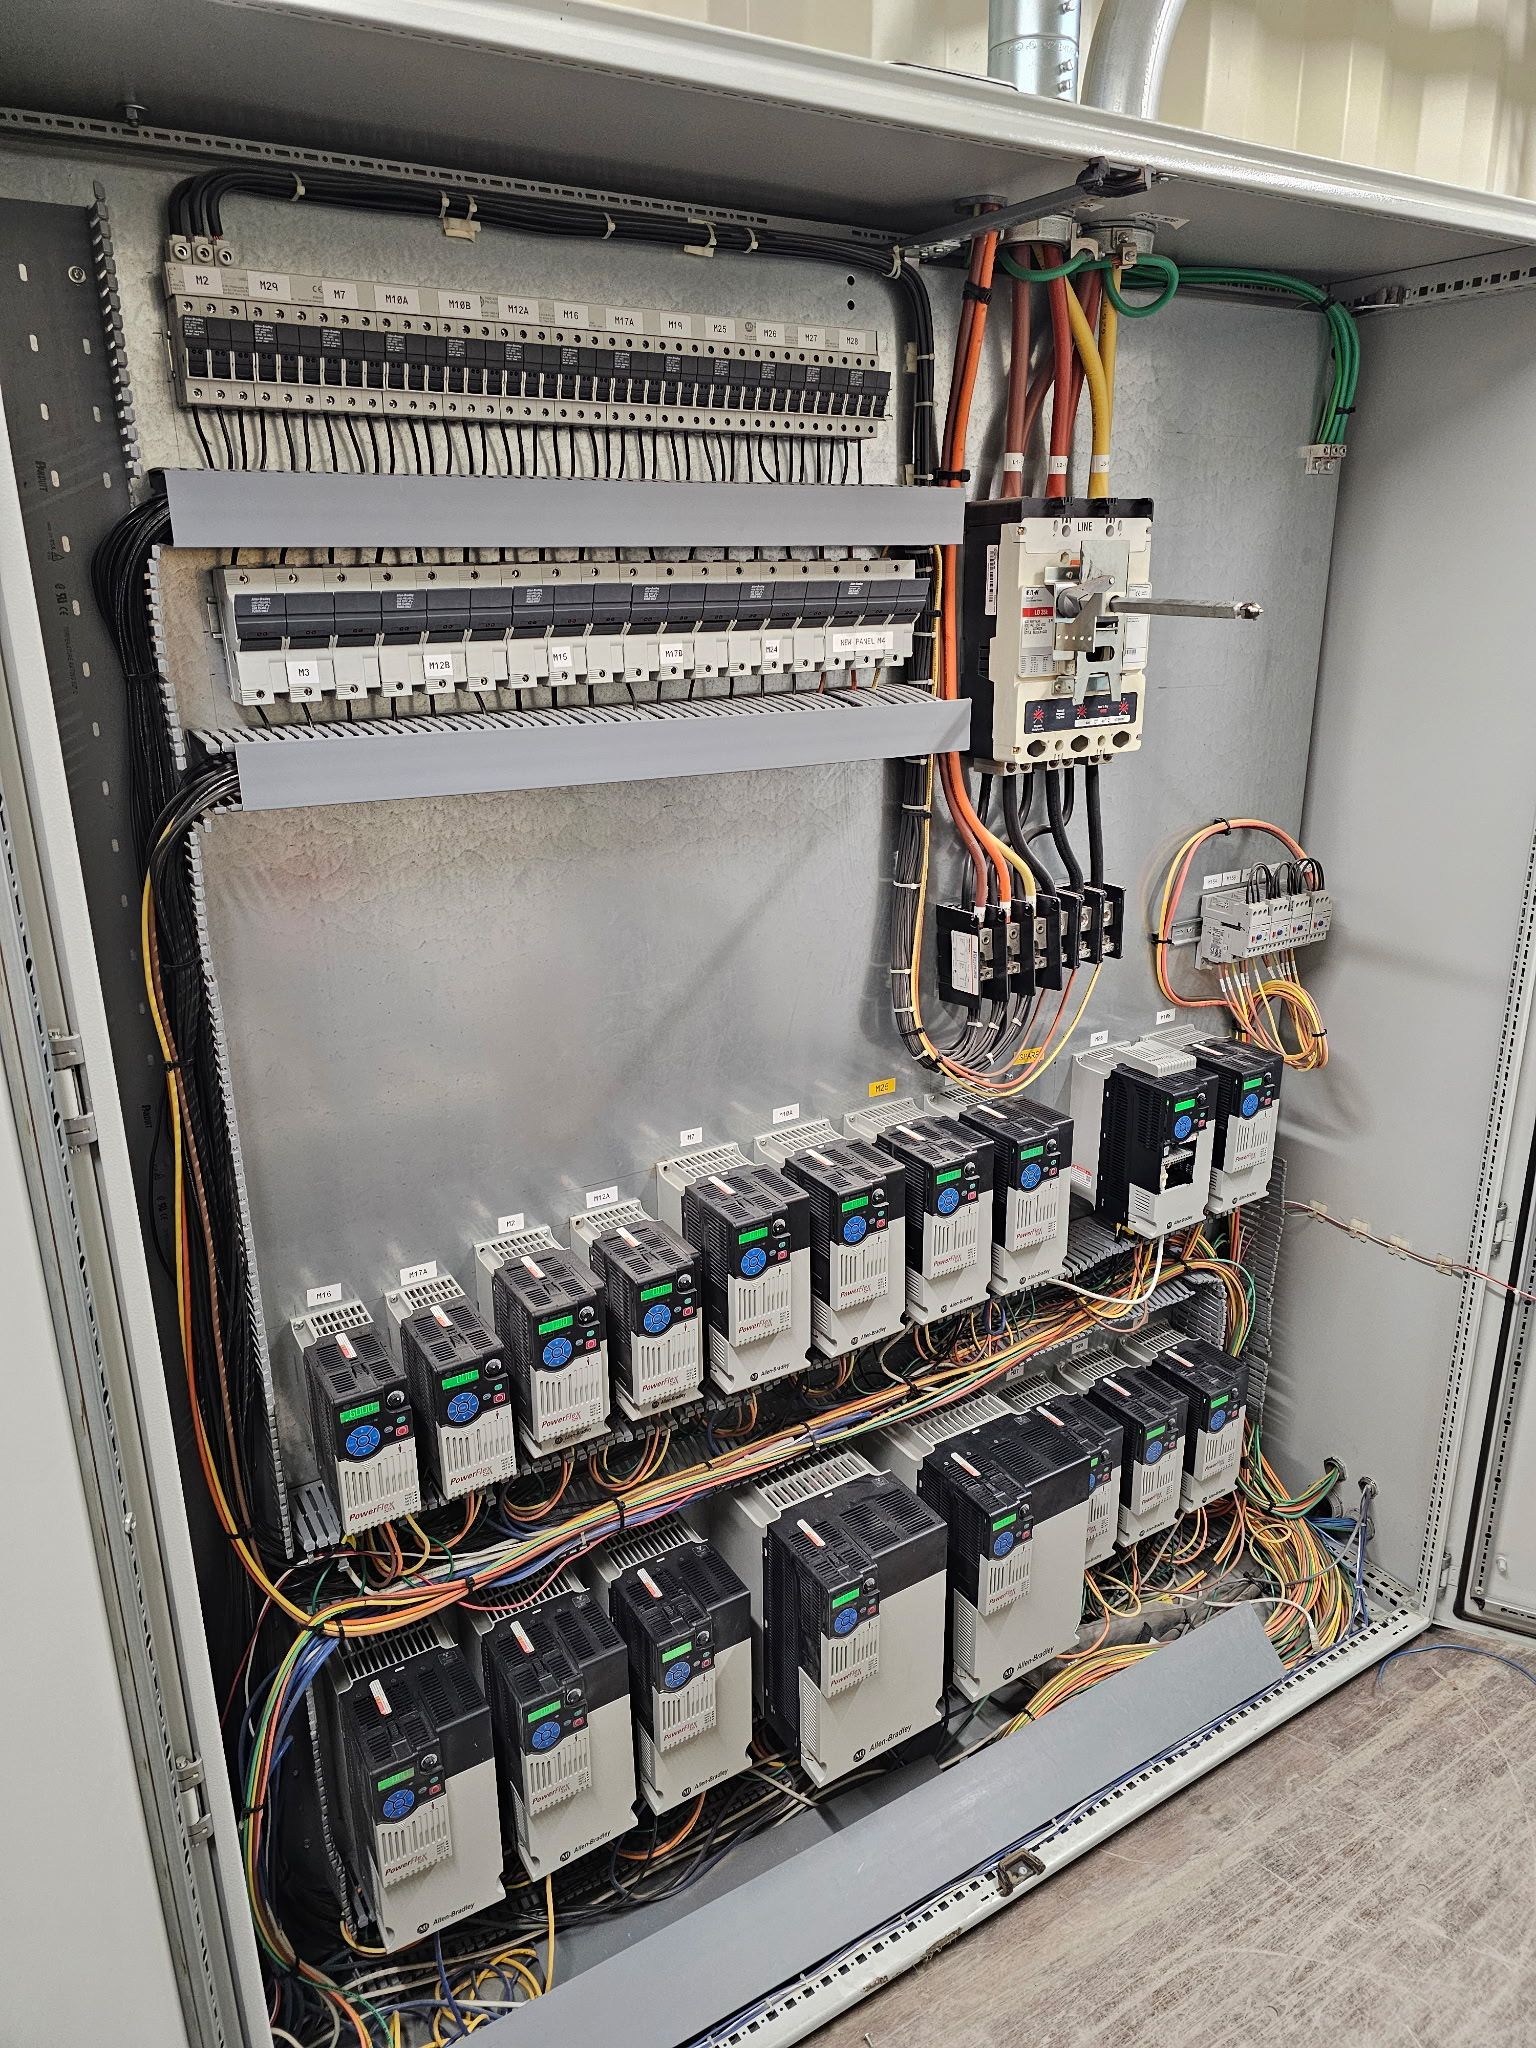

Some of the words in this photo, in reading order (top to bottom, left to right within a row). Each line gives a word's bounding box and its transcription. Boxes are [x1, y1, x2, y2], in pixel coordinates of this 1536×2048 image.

[195, 275, 209, 286] M2
[259, 280, 278, 292] M29
[333, 289, 346, 300] M7
[385, 294, 408, 305] M10A
[448, 299, 471, 310] M10B
[507, 304, 529, 315] M12A
[563, 310, 579, 320] M16
[614, 316, 634, 327] M17A
[668, 320, 683, 330] M19
[713, 324, 727, 334] M25
[763, 329, 777, 338] M26
[805, 334, 818, 342] M27
[846, 337, 859, 346] M28
[1077, 521, 1093, 532] LINE
[840, 638, 852, 647] NEW
[855, 637, 876, 646] PANEL
[552, 653, 568, 662] M15
[429, 661, 451, 671] M12B
[298, 668, 310, 677] M3
[687, 1133, 695, 1141] M7
[593, 1192, 611, 1202] M12A
[506, 1219, 516, 1228] M2
[408, 1268, 428, 1279] M17A
[1027, 1268, 1051, 1281] Allen-Bradley
[316, 1290, 332, 1300] M16
[950, 1295, 973, 1308] Allen-Bradley
[738, 1318, 774, 1334] PowerFlex
[861, 1326, 887, 1341] Allen-Bradley
[760, 1362, 791, 1377] Allen-Bradley
[642, 1375, 679, 1393] PowerFlex
[660, 1393, 687, 1405] Allen-Bradley
[541, 1411, 582, 1429] PowerFlex
[564, 1427, 592, 1442] Allen-Bradley
[450, 1466, 494, 1486] PowerFlex
[349, 1501, 396, 1522] PowerFlex
[1017, 1646, 1055, 1671] Allen-Bradley
[830, 1668, 862, 1687] PowerFlex
[663, 1721, 699, 1741] PowerFlex
[869, 1724, 913, 1752] Allen-Bradley
[694, 1768, 729, 1790] Allen-Bradley
[532, 1782, 571, 1805] PowerFlex
[574, 1829, 613, 1853] Allen-Bradley
[385, 1852, 428, 1877] PowerFlex
[433, 1902, 475, 1926] Allen-Bradley
